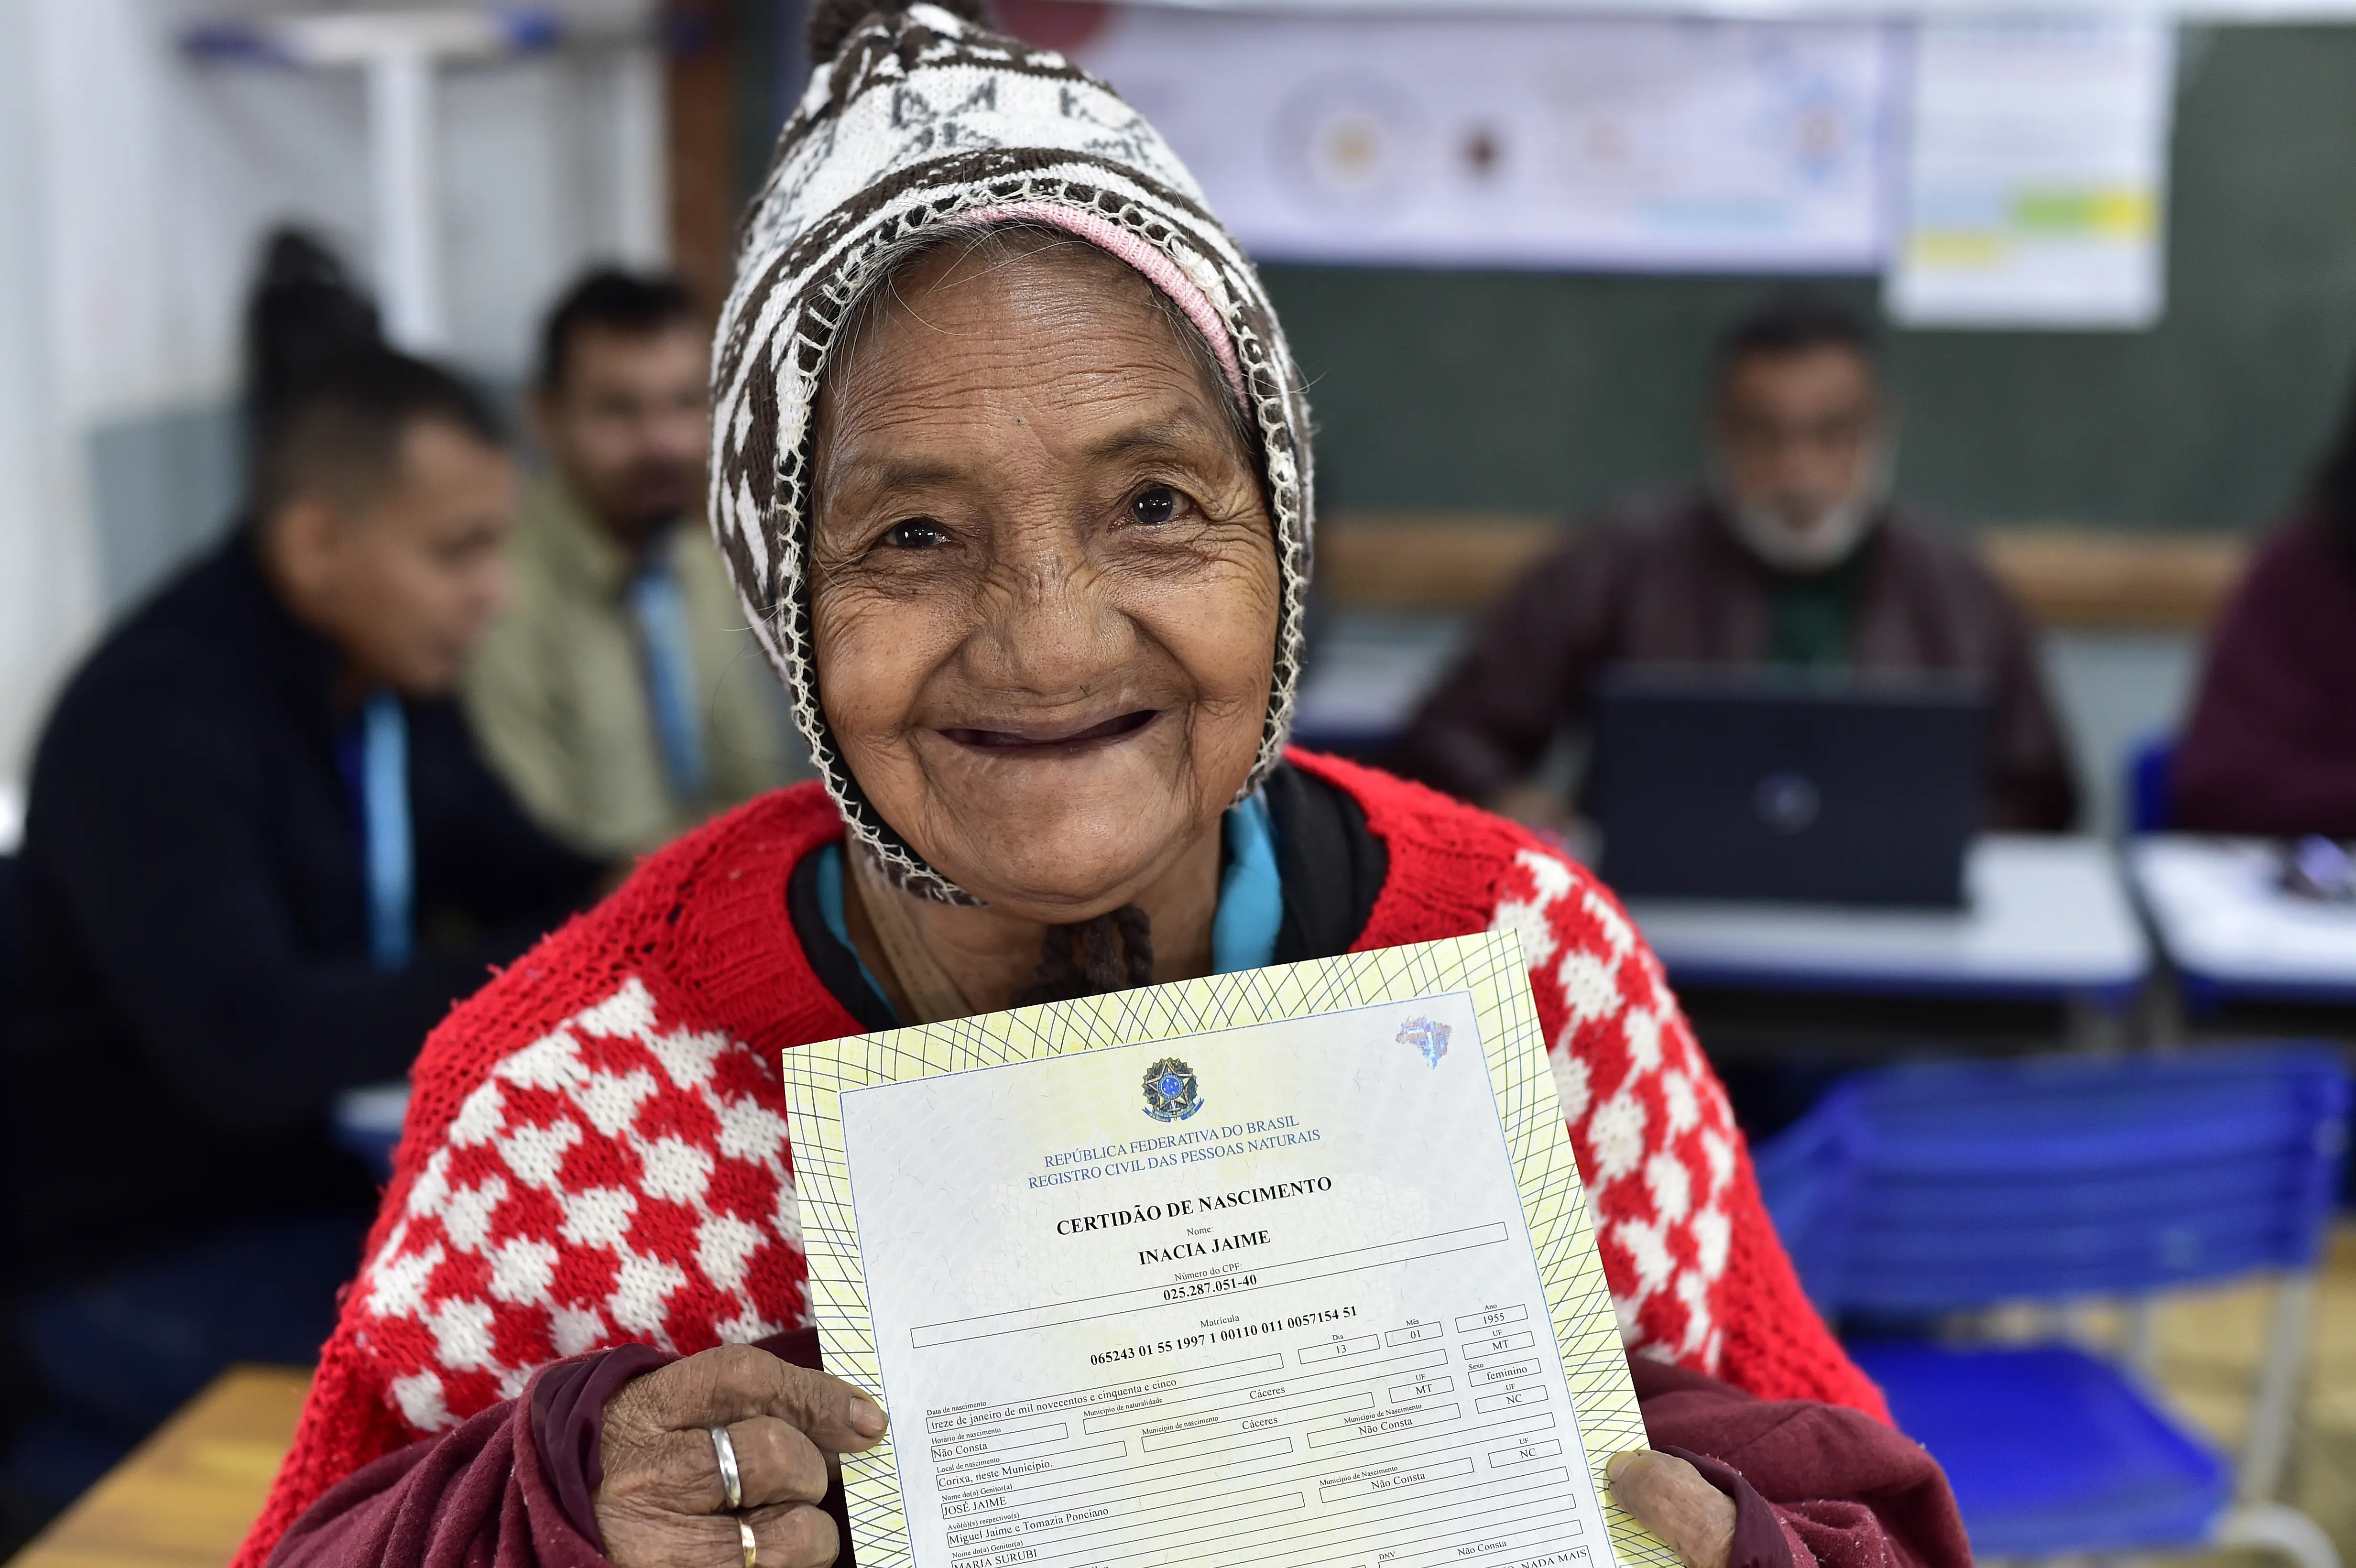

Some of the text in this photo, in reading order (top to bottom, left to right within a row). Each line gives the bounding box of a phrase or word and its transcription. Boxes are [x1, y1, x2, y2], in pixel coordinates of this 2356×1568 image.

[1044, 1115, 1299, 1168] REPÚBLICA FEDERATIVA DO BRASIL
[1028, 1129, 1320, 1189] REGISTRO CIVIL DAS PESSOAS NATURAIS
[1057, 1176, 1332, 1235] CERTIDÃO DE NASCIMENTO
[1186, 1226, 1214, 1236] Nome:
[1137, 1230, 1271, 1266] INACIA JAIME
[1174, 1262, 1243, 1282] Número do CPF:
[1163, 1274, 1257, 1301] 025.287.051-40
[1406, 1318, 1419, 1327] Mês
[1483, 1312, 1505, 1325] 1955
[1090, 1305, 1356, 1365] 065243 01 55 1997 1 00110 011 0057154 51
[1410, 1329, 1421, 1339] 01
[1336, 1344, 1347, 1354] 13
[1491, 1339, 1509, 1351] MT
[1415, 1373, 1425, 1381] UF
[1487, 1366, 1527, 1381] feminino
[1250, 1387, 1286, 1399] Cáceres
[1415, 1383, 1432, 1395] MT
[931, 1420, 954, 1429] treze
[956, 1416, 967, 1425] de
[969, 1410, 1002, 1426] janeiro
[1004, 1407, 1016, 1416] de
[1018, 1403, 1034, 1415] mil
[1036, 1396, 1088, 1411] novecentos
[1098, 1385, 1143, 1400] cinquenta
[1152, 1380, 1177, 1390] cinco
[951, 1401, 987, 1412] nascimento
[1125, 1397, 1163, 1410] naturalidade
[1505, 1394, 1522, 1405] NC
[1344, 1412, 1375, 1424] Município
[1385, 1404, 1422, 1416] Nascimento
[1141, 1424, 1174, 1436] Município
[1184, 1416, 1219, 1427] nascimento
[1242, 1417, 1278, 1429] Cáceres
[1358, 1418, 1413, 1435] Não Consta
[931, 1435, 956, 1445] Horário
[966, 1428, 1001, 1438] nascimento
[933, 1443, 988, 1459] Não Consta
[1518, 1448, 1537, 1459] NC
[936, 1464, 954, 1473] Local
[965, 1458, 1000, 1469] nascimento
[938, 1459, 1053, 1487] Corixa, neste Município.
[1319, 1471, 1352, 1486] Município
[1362, 1466, 1398, 1478] Nascimento
[1370, 1473, 1426, 1490] Não Consta
[941, 1483, 1013, 1502] Nome do(a) Genitor(a)
[944, 1496, 1007, 1516] JOSÉ JAIME
[949, 1530, 982, 1545] Miguel
[985, 1526, 1013, 1538] Jaime
[1022, 1515, 1064, 1530] Tomazia
[1065, 1508, 1109, 1522] Ponciano
[979, 1512, 1020, 1525] respectivo(s)
[952, 1540, 1023, 1559] Nome do(a) Genitor(a)
[995, 1548, 1037, 1565] SURUBI
[1379, 1551, 1395, 1560] DNV
[1457, 1541, 1507, 1557] Não Consta
[1520, 1549, 1587, 1568] NADA MAIS
